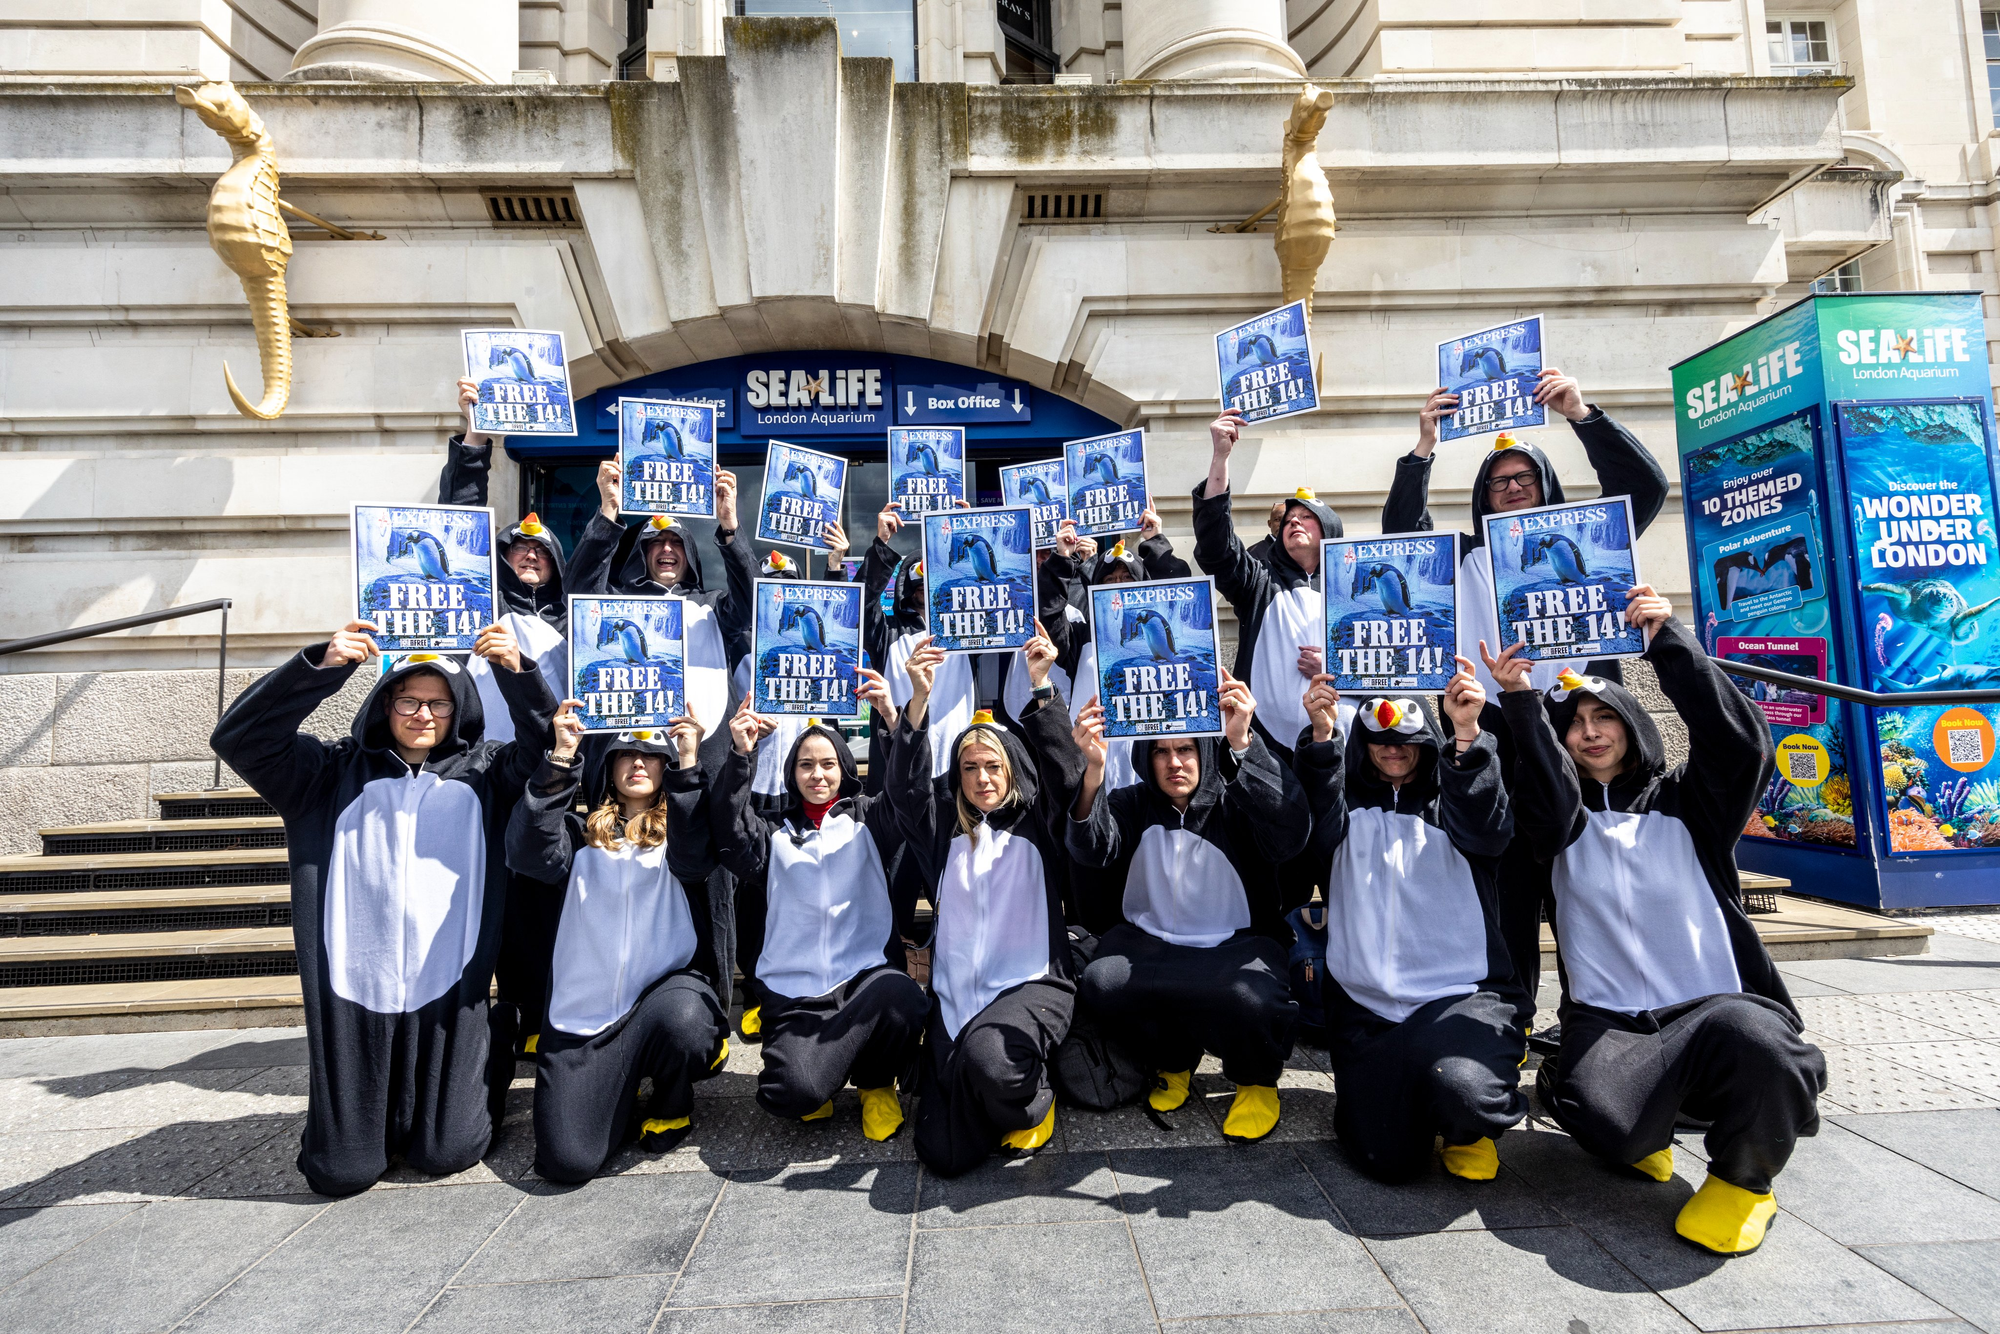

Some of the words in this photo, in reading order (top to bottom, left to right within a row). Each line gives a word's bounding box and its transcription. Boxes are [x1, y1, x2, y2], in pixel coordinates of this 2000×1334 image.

[1238, 310, 1290, 336] EXPRESS
[1464, 324, 1526, 348] EXPRESS
[1837, 329, 1901, 365] SEA
[1239, 362, 1291, 393] FREE
[1853, 367, 1897, 379] London
[1900, 366, 1959, 381] Aquarium
[491, 384, 549, 404] FREE
[747, 370, 811, 408] SEA
[1231, 387, 1272, 410] THE
[1278, 378, 1305, 403] 14!
[1461, 378, 1519, 408] FREE
[1686, 372, 1738, 419] SEA
[482, 404, 529, 422] THE
[535, 404, 562, 422] 14!
[646, 405, 700, 419] EXPRESS
[928, 398, 955, 409] Box
[958, 396, 1000, 408] Office
[1451, 402, 1496, 429] THE
[1504, 396, 1533, 418] 14!
[1699, 408, 1736, 429] London
[1737, 385, 1791, 413] Aquarium
[758, 412, 806, 424] London
[811, 412, 875, 426] Aquarium
[909, 432, 952, 440] EXPRESS
[1086, 436, 1132, 452] EXPRESS
[790, 450, 834, 468] EXPRESS
[1019, 463, 1060, 476] EXPRESS
[642, 461, 694, 482] FREE
[1723, 476, 1748, 489] Enjoy
[1751, 468, 1773, 480] over
[632, 481, 673, 502] THE
[680, 484, 704, 504] 14!
[906, 478, 948, 494] FREE
[1084, 484, 1129, 507] FREE
[1702, 498, 1720, 515] 10
[1724, 473, 1802, 508] THEMED
[1889, 481, 1936, 491] Discover
[1940, 480, 1958, 490] the
[780, 496, 823, 520] FREE
[898, 495, 931, 512] THE
[936, 495, 956, 510] 14!
[1034, 505, 1060, 522] REE
[1076, 504, 1112, 526] THE
[1117, 500, 1140, 520] 14!
[1721, 496, 1782, 527] ZONES
[1862, 494, 1984, 518] WONDER
[391, 511, 472, 526] EXPRESS
[770, 512, 804, 534] THE
[952, 514, 1016, 530] EXPRESS
[1522, 507, 1607, 530] EXPRESS
[1719, 541, 1741, 554] Polar
[1743, 525, 1791, 546] Adventure
[1879, 519, 1974, 543] UNDER
[1357, 540, 1436, 558] EXPRESS
[1871, 543, 1987, 568] LONDON
[388, 583, 466, 609] FREE
[784, 588, 847, 601] EXPRESS
[951, 584, 1011, 611] FREE
[1123, 586, 1194, 605] EXPRESS
[1525, 584, 1607, 618] FREE
[1769, 590, 1792, 599] Antarctic
[602, 602, 668, 614] EXPRESS
[1748, 608, 1768, 617] penguin
[372, 610, 435, 636] THE
[446, 610, 481, 636] 14!
[940, 612, 987, 637] THE
[995, 610, 1025, 635] 14!
[1352, 619, 1426, 646] FREE
[1512, 616, 1575, 646] THE
[1586, 611, 1627, 641] 14!
[1767, 642, 1799, 650] Tunnel
[778, 653, 836, 677] FREE
[1338, 648, 1395, 675] THE
[1406, 647, 1443, 674] 14!
[598, 667, 660, 690] FREE
[765, 677, 811, 701] THE
[820, 679, 848, 702] 14!
[1123, 663, 1192, 693] FREE
[584, 692, 636, 716] THE
[644, 690, 674, 714] 14!
[1112, 693, 1166, 721] THE
[1174, 690, 1208, 718] 14!
[1941, 719, 1962, 727] Book
